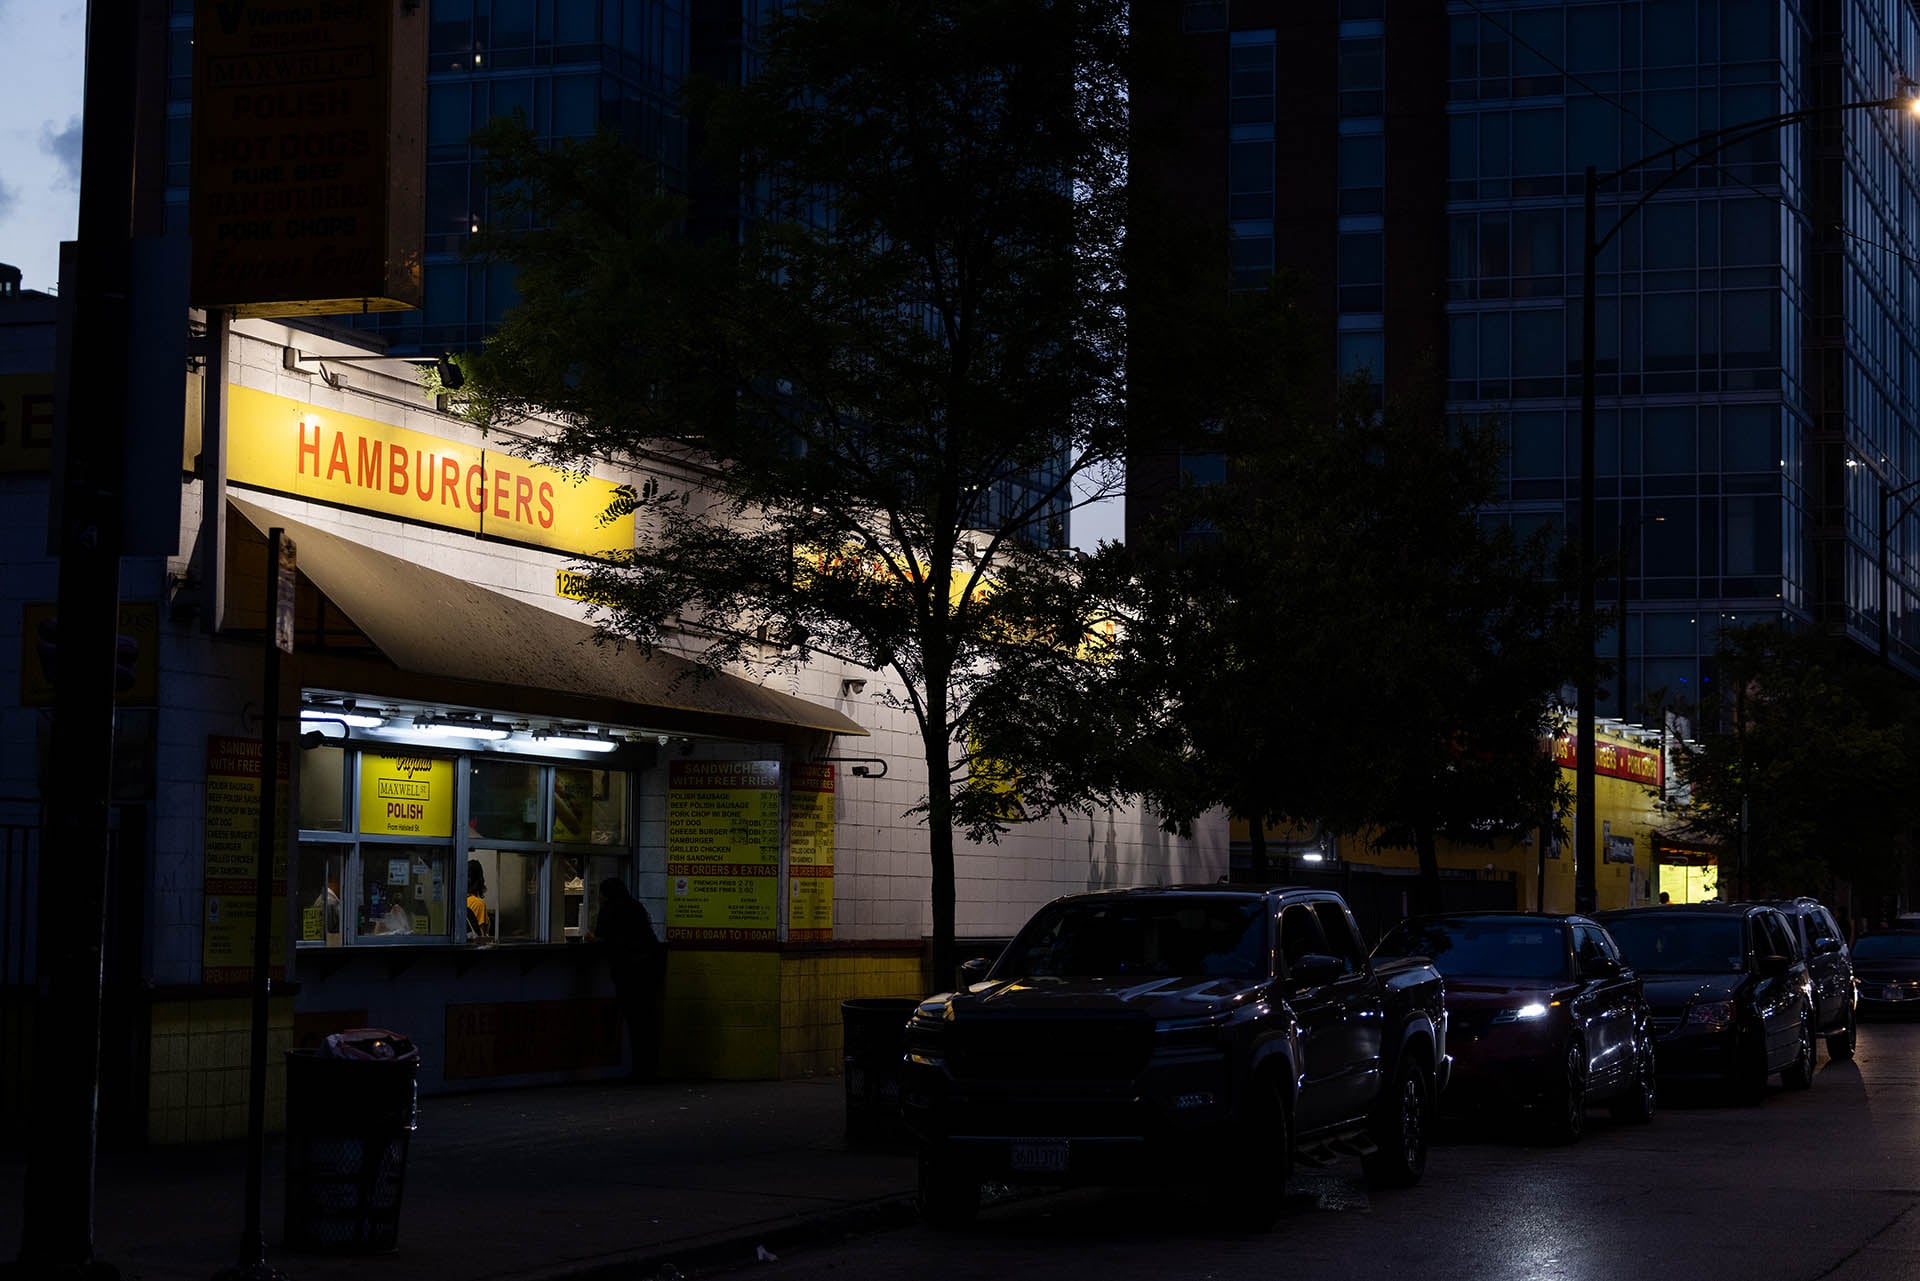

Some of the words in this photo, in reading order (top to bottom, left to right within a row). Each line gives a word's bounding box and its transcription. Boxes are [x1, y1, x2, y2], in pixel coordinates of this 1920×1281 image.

[232, 89, 350, 120] POLISH
[208, 136, 271, 164] HOT
[280, 130, 370, 160] DOGS
[232, 166, 284, 184] PURE
[295, 163, 344, 181] BEEF
[218, 221, 273, 241] PORK
[286, 216, 357, 237] CHOPS
[298, 422, 555, 529] HAMBURGERS
[685, 762, 766, 775] SANDWICHES
[380, 782, 420, 796] MAXWELL
[672, 777, 704, 785] WITH
[708, 776, 736, 785] FREE
[742, 776, 776, 785] FRIES
[387, 802, 423, 819] POLISH
[669, 866, 690, 874] SIDE
[692, 866, 730, 875] ORDERS
[741, 866, 777, 875] EXTRAS
[668, 929, 693, 939] OPEN
[729, 931, 741, 940] TO
